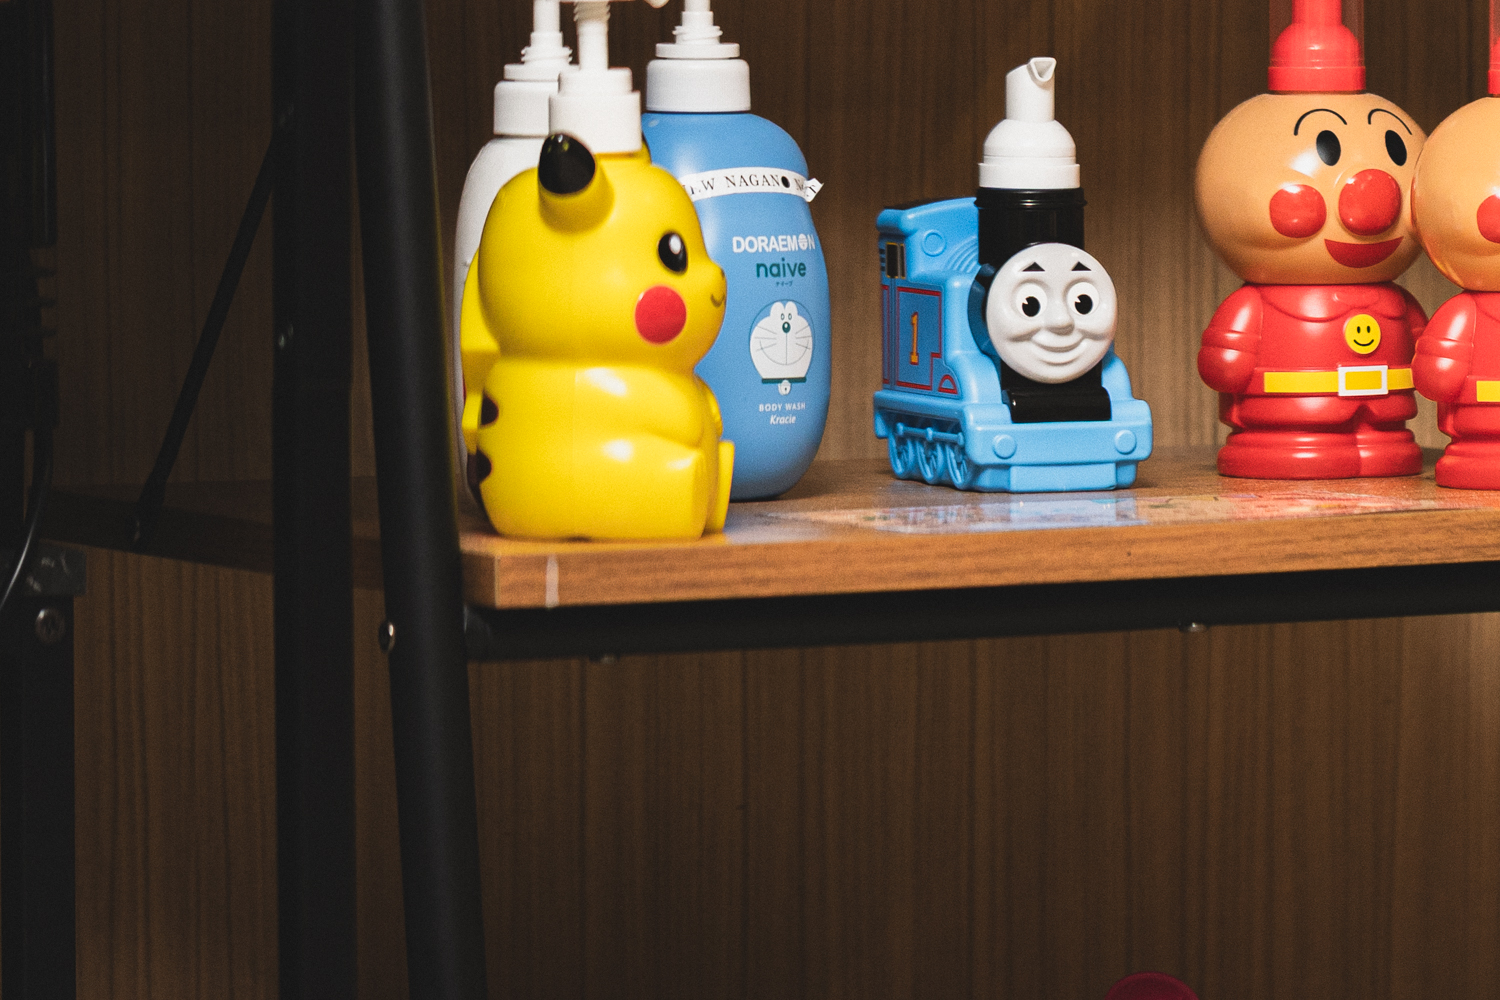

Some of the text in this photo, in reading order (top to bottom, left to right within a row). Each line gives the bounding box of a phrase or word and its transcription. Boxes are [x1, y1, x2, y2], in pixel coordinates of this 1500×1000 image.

[732, 233, 816, 253] DORAEMON
[756, 258, 807, 279] naive
[910, 311, 919, 366] 1
[758, 402, 806, 412] BODY WASH
[769, 413, 797, 426] Kracie
